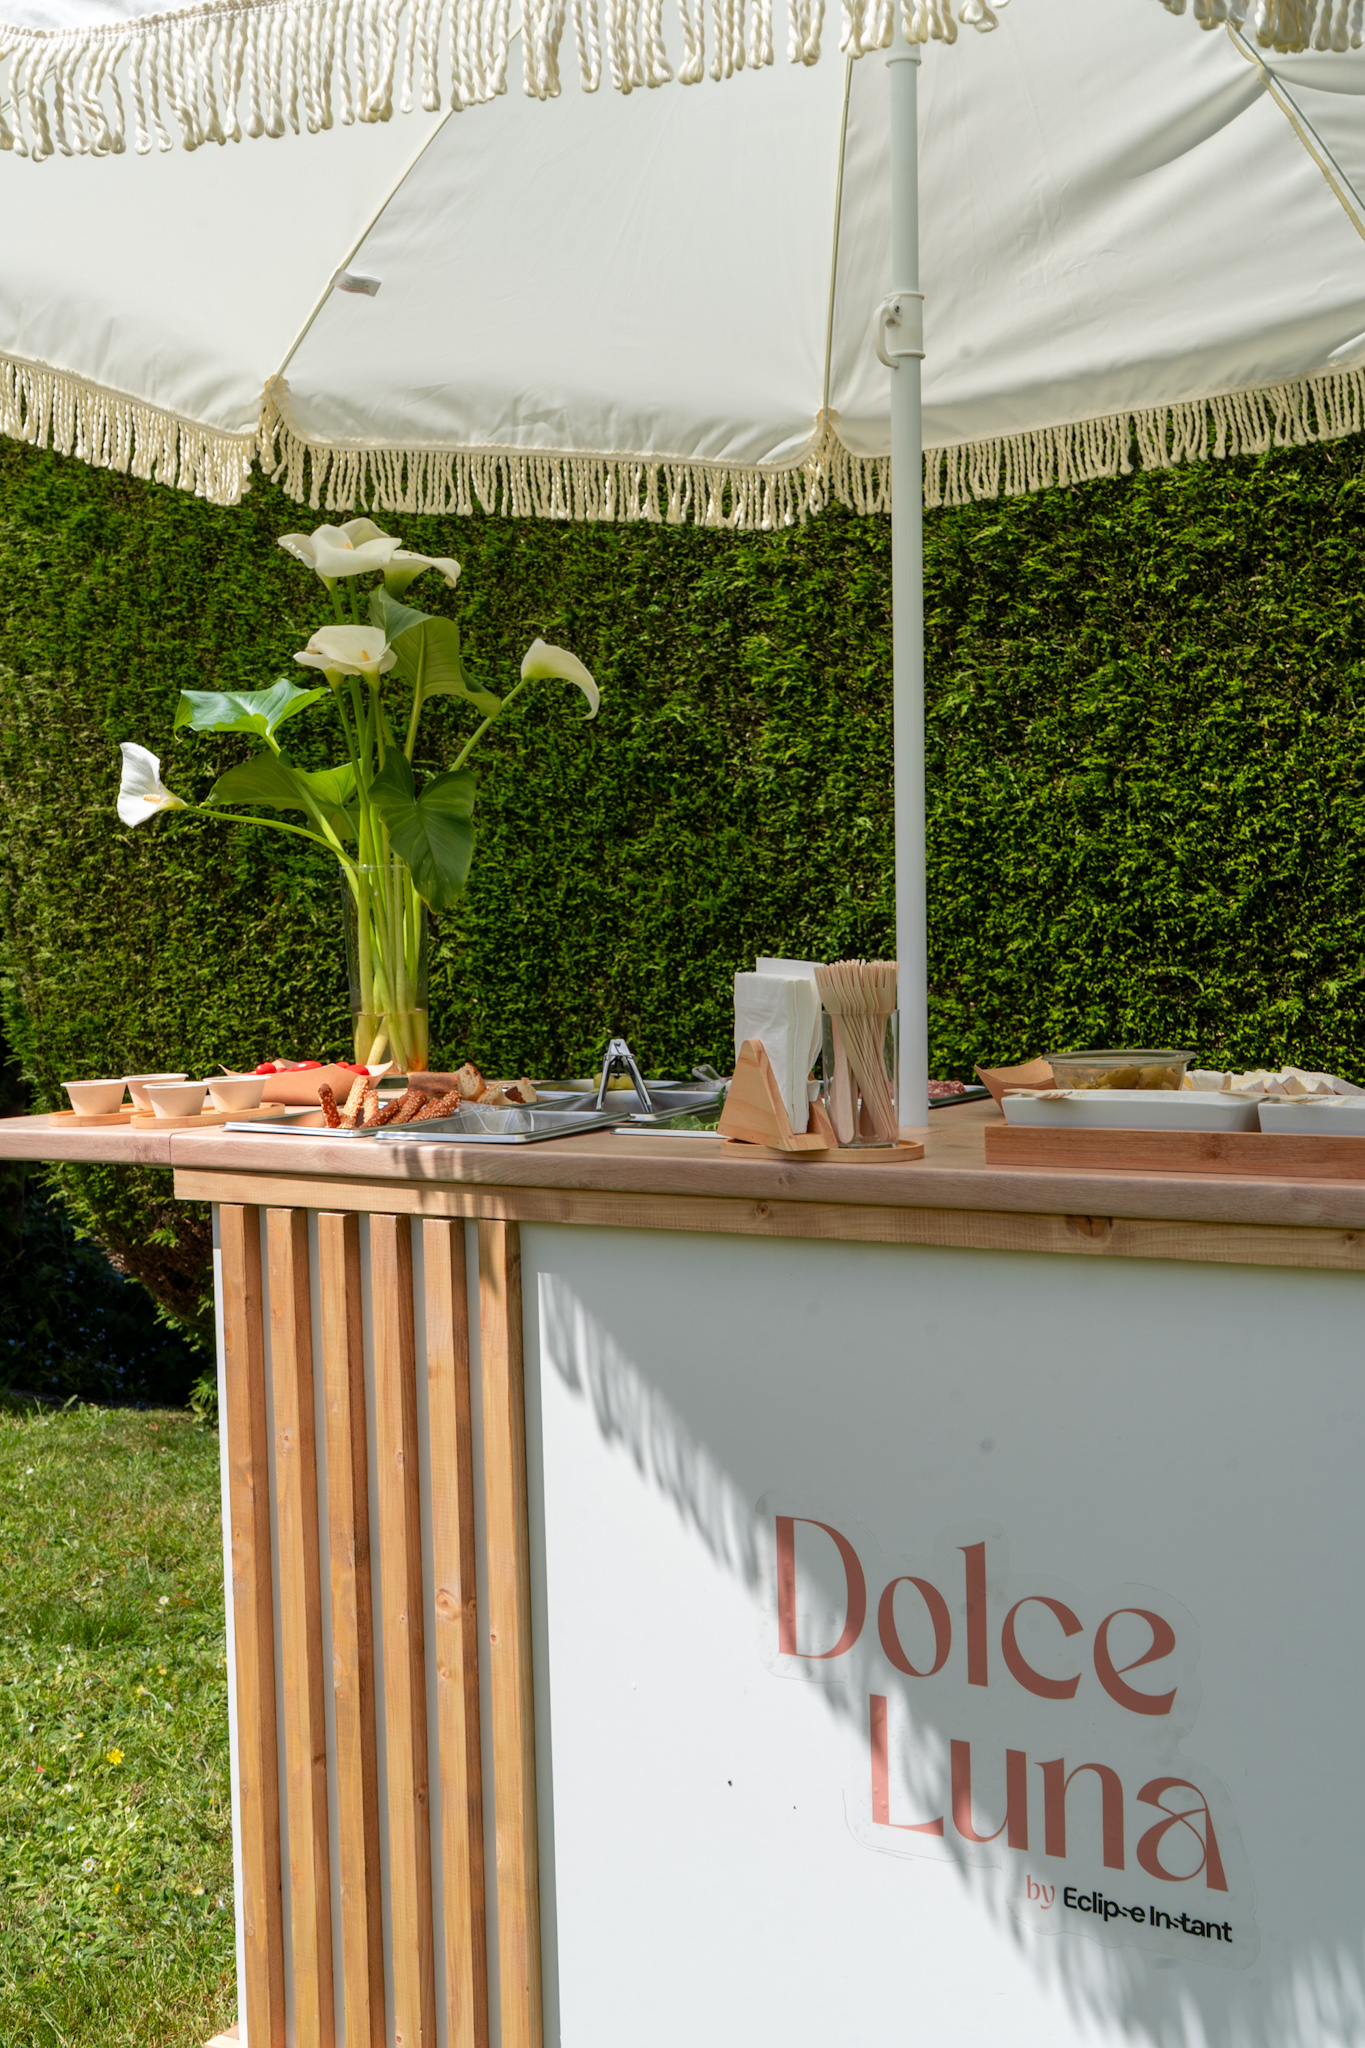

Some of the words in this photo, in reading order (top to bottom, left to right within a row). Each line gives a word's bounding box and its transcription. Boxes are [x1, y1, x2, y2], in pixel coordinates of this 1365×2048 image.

[775, 1515, 1178, 1716] Dolce
[869, 1693, 1229, 1893] Luna
[1025, 1874, 1056, 1910] by
